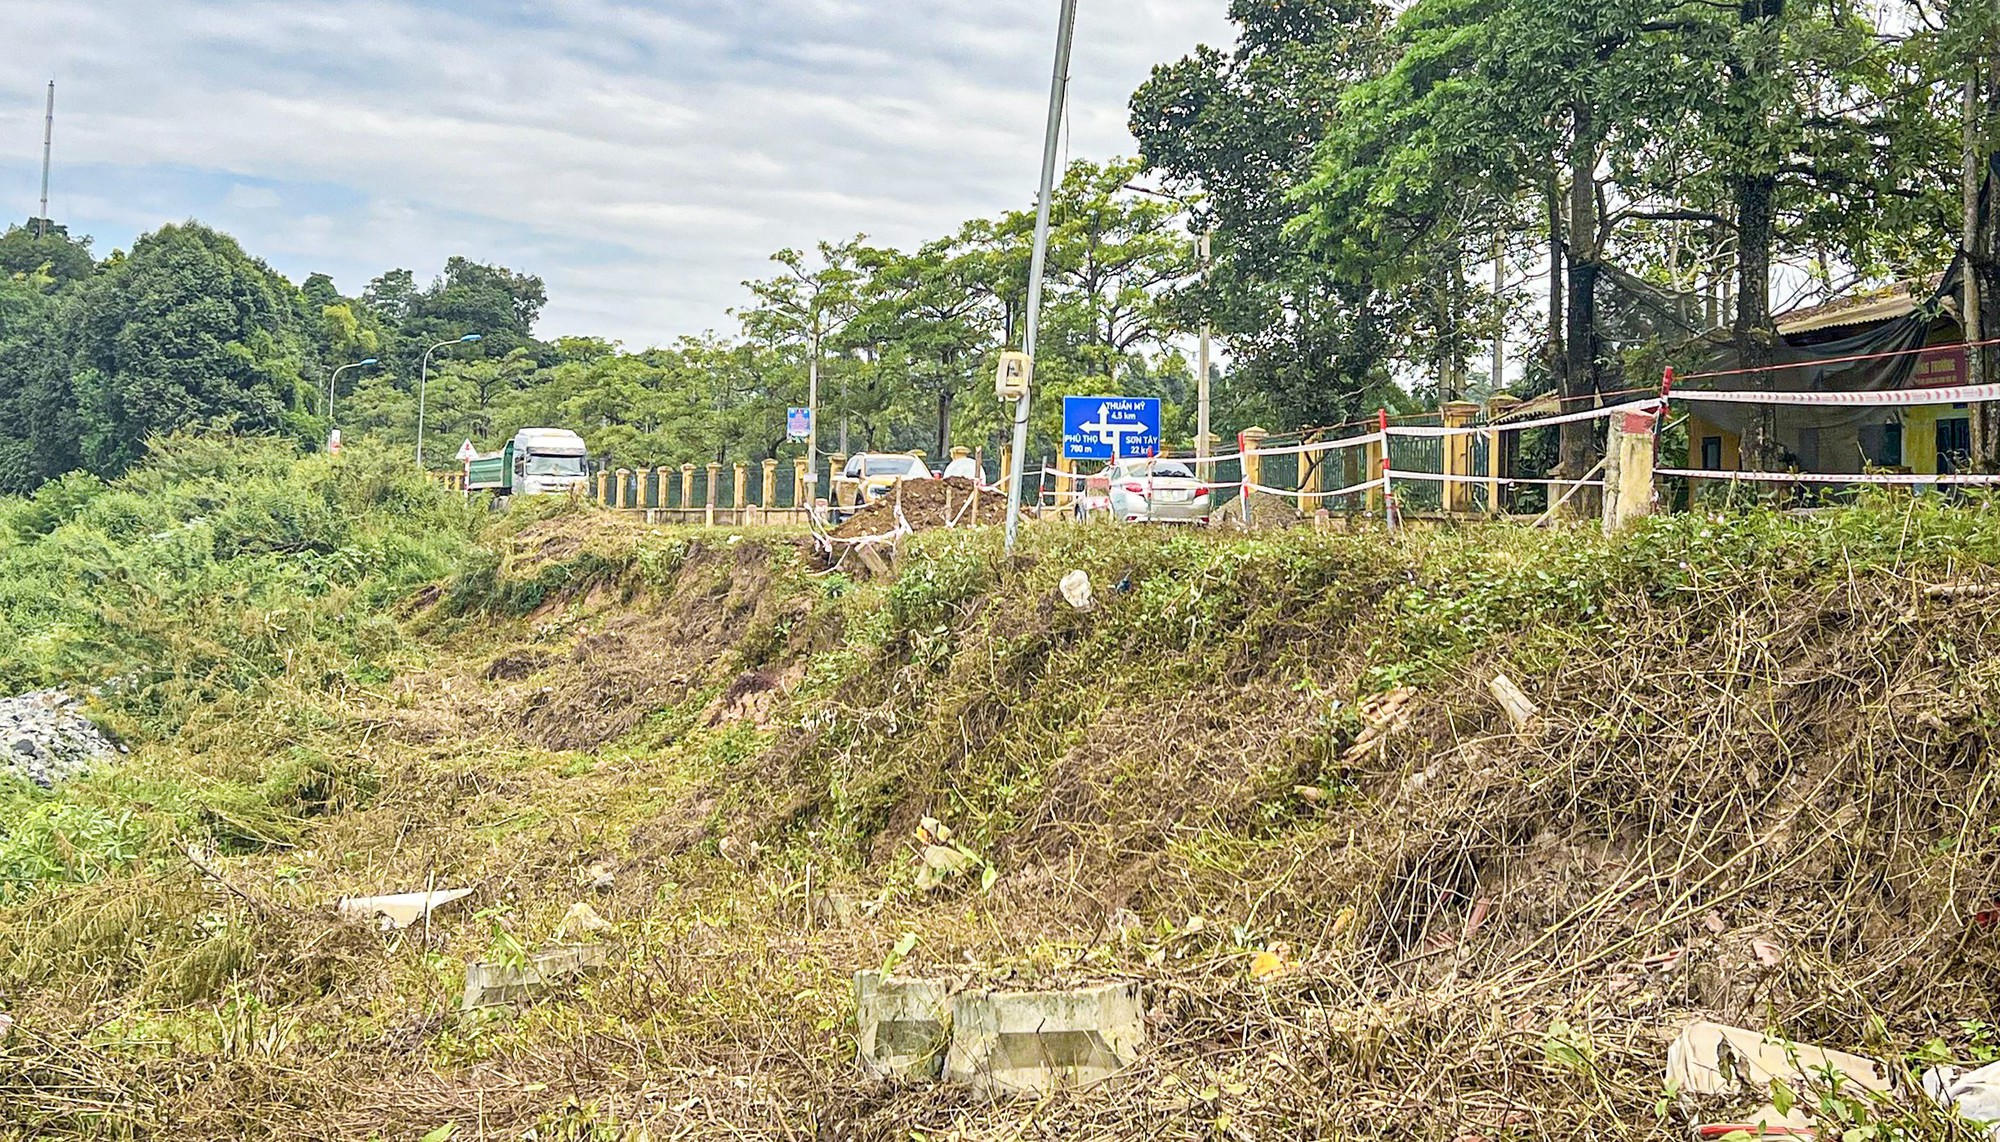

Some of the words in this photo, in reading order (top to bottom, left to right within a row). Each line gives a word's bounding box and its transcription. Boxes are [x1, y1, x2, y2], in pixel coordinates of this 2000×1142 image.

[1124, 411, 1136, 420] km
[1082, 434, 1098, 445] THỌ
[1125, 435, 1142, 444] SƠN
[1143, 434, 1158, 444] TÂY
[1070, 444, 1083, 453] 700
[1130, 446, 1140, 454] 22
